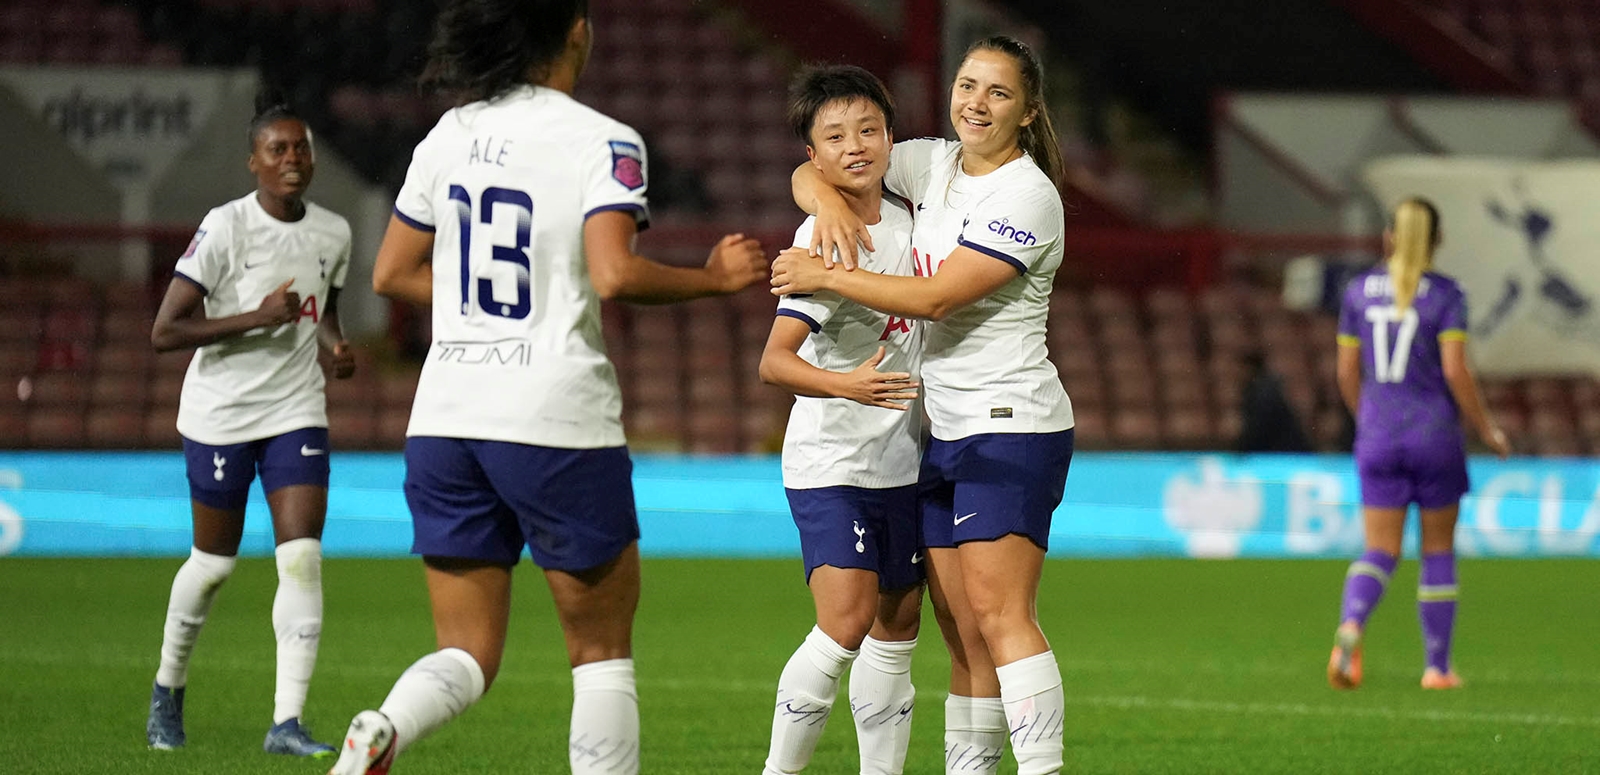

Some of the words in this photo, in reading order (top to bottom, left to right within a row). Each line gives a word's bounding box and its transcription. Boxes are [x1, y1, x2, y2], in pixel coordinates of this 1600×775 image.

[469, 136, 513, 167] ALE
[448, 184, 533, 320] 13
[988, 217, 1036, 246] cinch
[1364, 305, 1419, 383] 17
